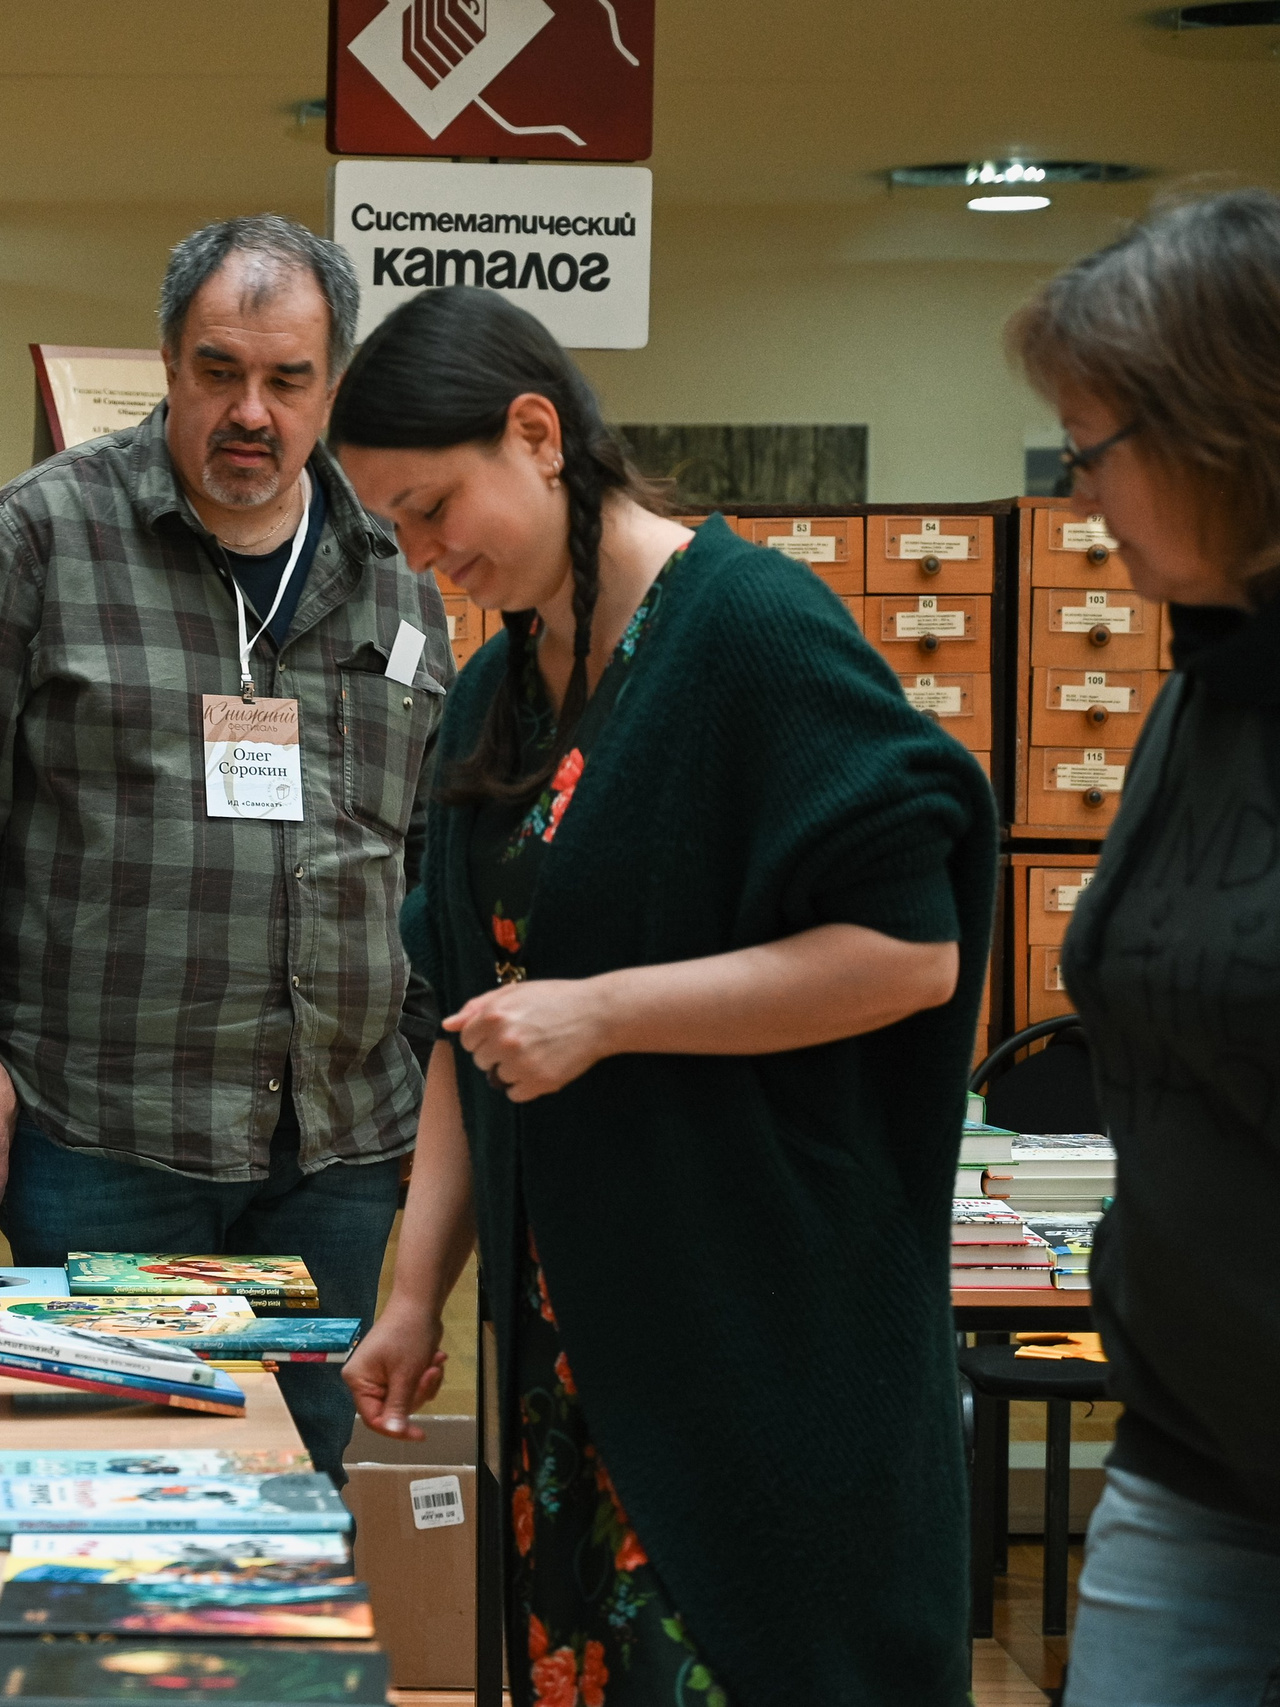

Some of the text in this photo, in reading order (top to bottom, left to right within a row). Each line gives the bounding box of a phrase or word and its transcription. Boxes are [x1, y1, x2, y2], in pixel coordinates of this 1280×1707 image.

[351, 202, 637, 238] Систематический
[372, 246, 611, 293] каталог
[796, 524, 808, 532] 53
[925, 523, 937, 531] 54
[922, 600, 934, 608] 60
[1088, 596, 1105, 604] 103
[920, 678, 931, 687] 66
[1087, 676, 1104, 685] 109
[204, 701, 298, 726] Книжный
[233, 748, 272, 762] Олег
[1086, 752, 1103, 761] 115
[218, 762, 288, 778] Сорокин
[227, 799, 283, 808] ИД «Самокат»
